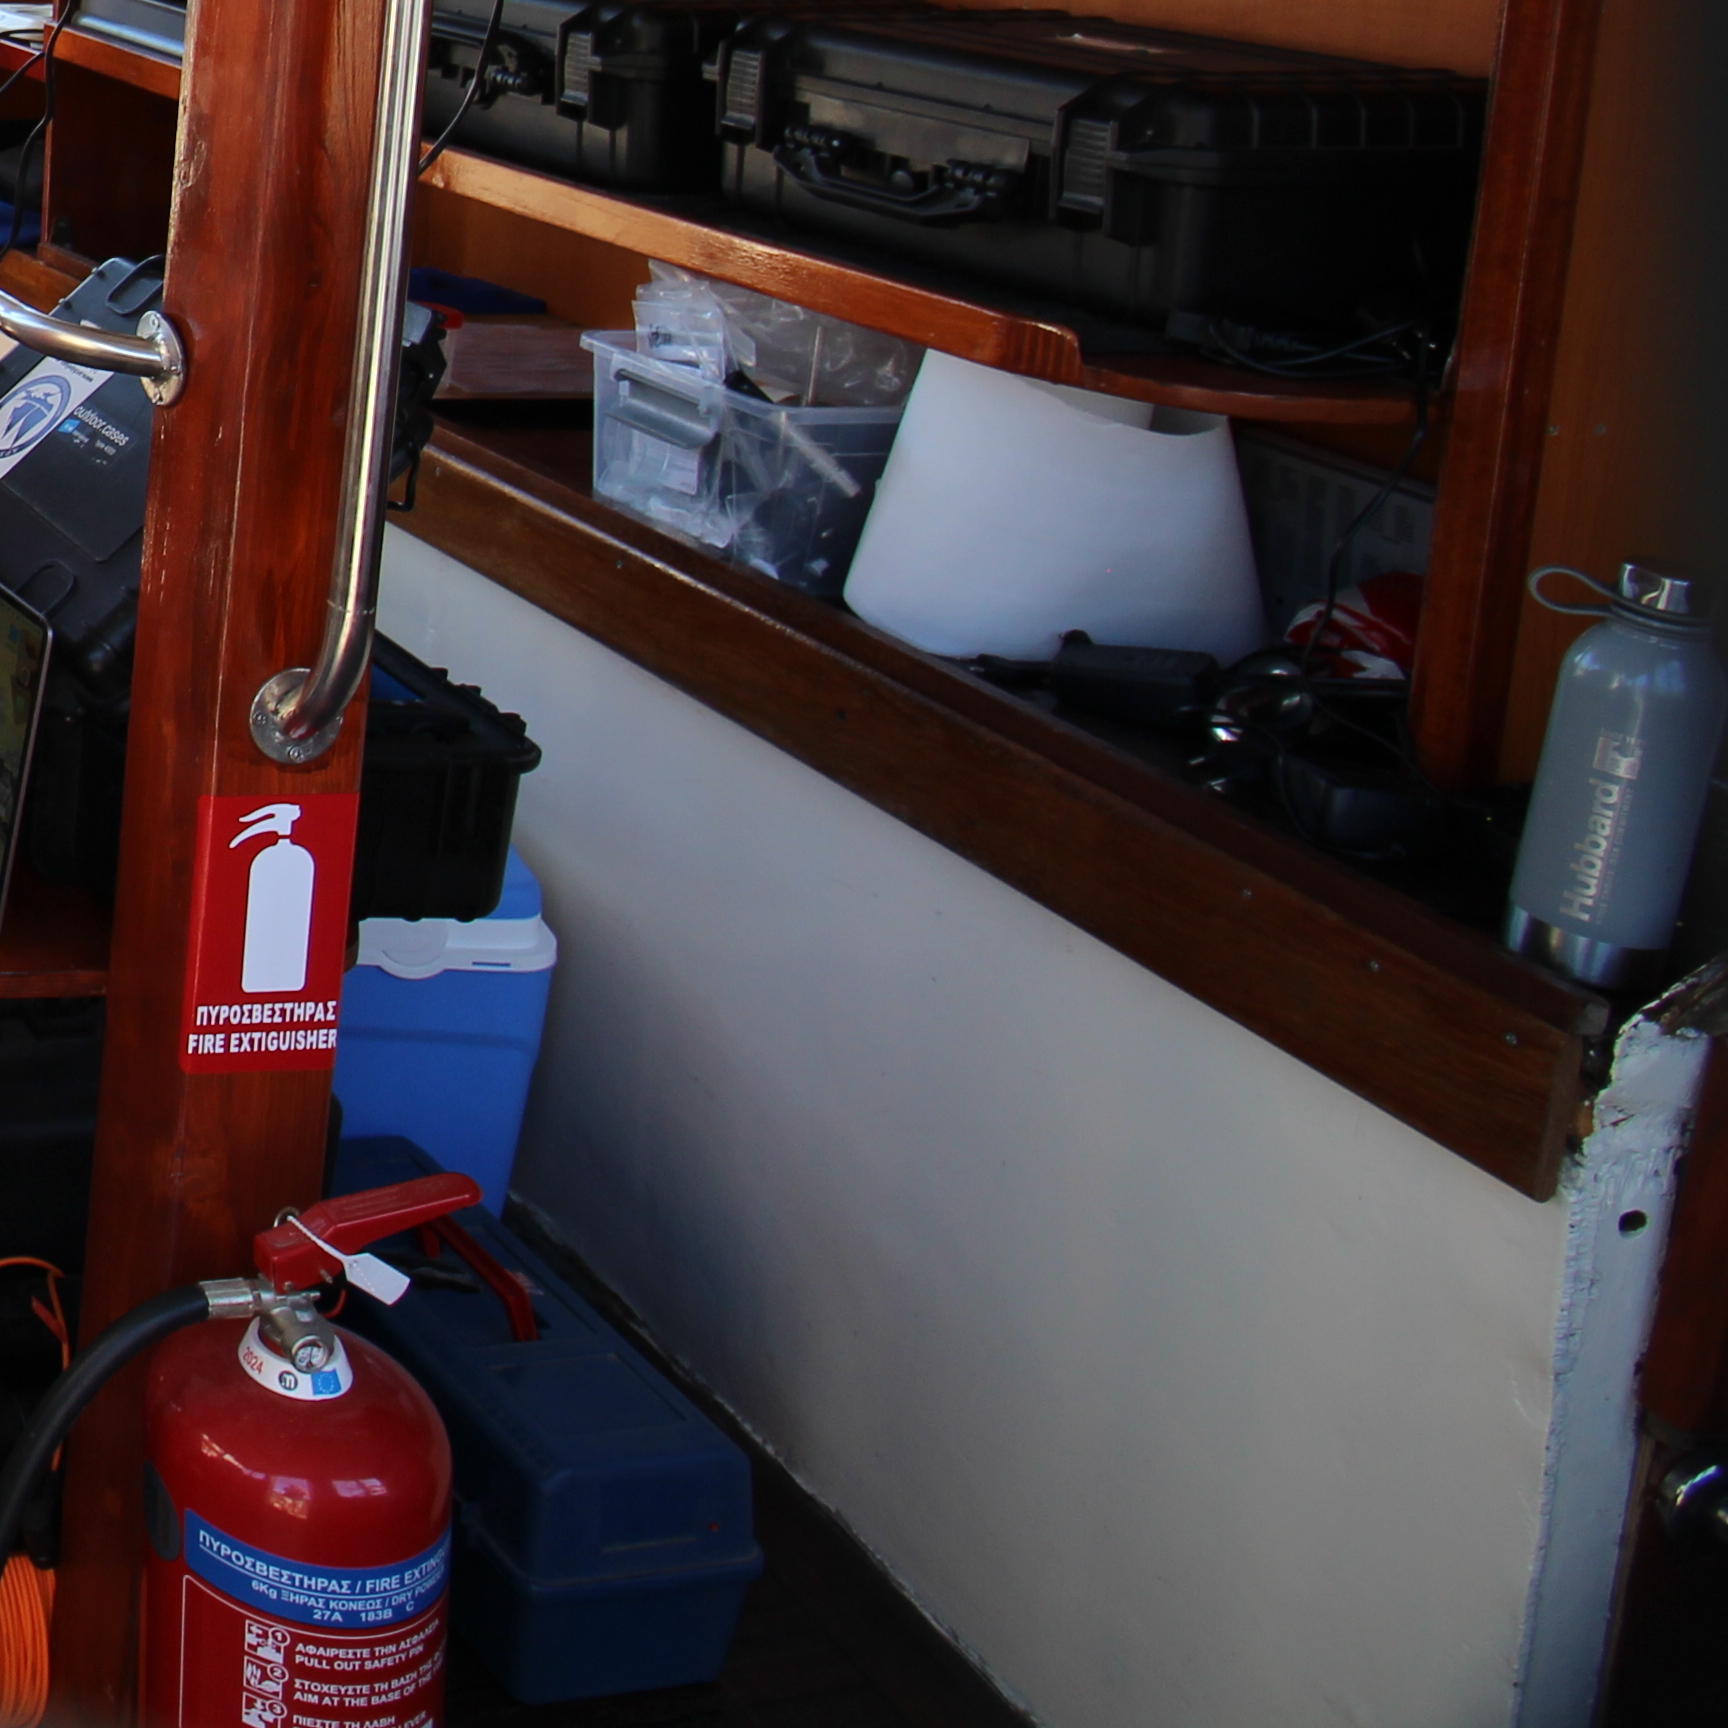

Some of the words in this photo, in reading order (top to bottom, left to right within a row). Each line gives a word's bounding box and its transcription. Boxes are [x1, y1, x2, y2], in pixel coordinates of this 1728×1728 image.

[74, 405, 130, 447] outdoor.cases
[1559, 777, 1622, 923] Hubbard
[196, 1000, 337, 1027] ΠΥΡΟΣΒΕΣΤΗΡΑΣ
[187, 1033, 226, 1055] FIRE
[229, 1028, 338, 1054] EXTIGUISHER
[243, 1346, 264, 1375] 2024
[199, 1529, 352, 1594] ΠΥΡΟΣΒΕΣΤΗΡΑΣ
[365, 1574, 401, 1594] FIRE
[251, 1579, 278, 1600] 6Kg
[280, 1589, 327, 1609] ΞΗΡΑΣ
[329, 1597, 383, 1611] ΚΟΝΕΩΣ
[391, 1589, 414, 1606] DRY
[312, 1609, 343, 1622] 27A
[359, 1608, 393, 1623] 183B
[405, 1600, 414, 1612] C
[295, 1642, 371, 1659] ΑΦΑΙΡΕΣΤΕ
[374, 1643, 397, 1657] ΤΗΝ
[295, 1654, 331, 1670] PULL
[333, 1659, 361, 1671] OUT
[363, 1651, 408, 1670] SAFETY
[408, 1643, 424, 1658] PIN
[293, 1678, 371, 1696] ΣΤΟΧΕΥΣΤΕ
[373, 1681, 389, 1693] ΤΗ
[391, 1670, 417, 1690] ΒΑΣΗ
[293, 1691, 319, 1705] AIM
[321, 1696, 340, 1707] AT
[343, 1696, 369, 1707] THE
[371, 1688, 402, 1706] BASE
[403, 1681, 417, 1697] OF
